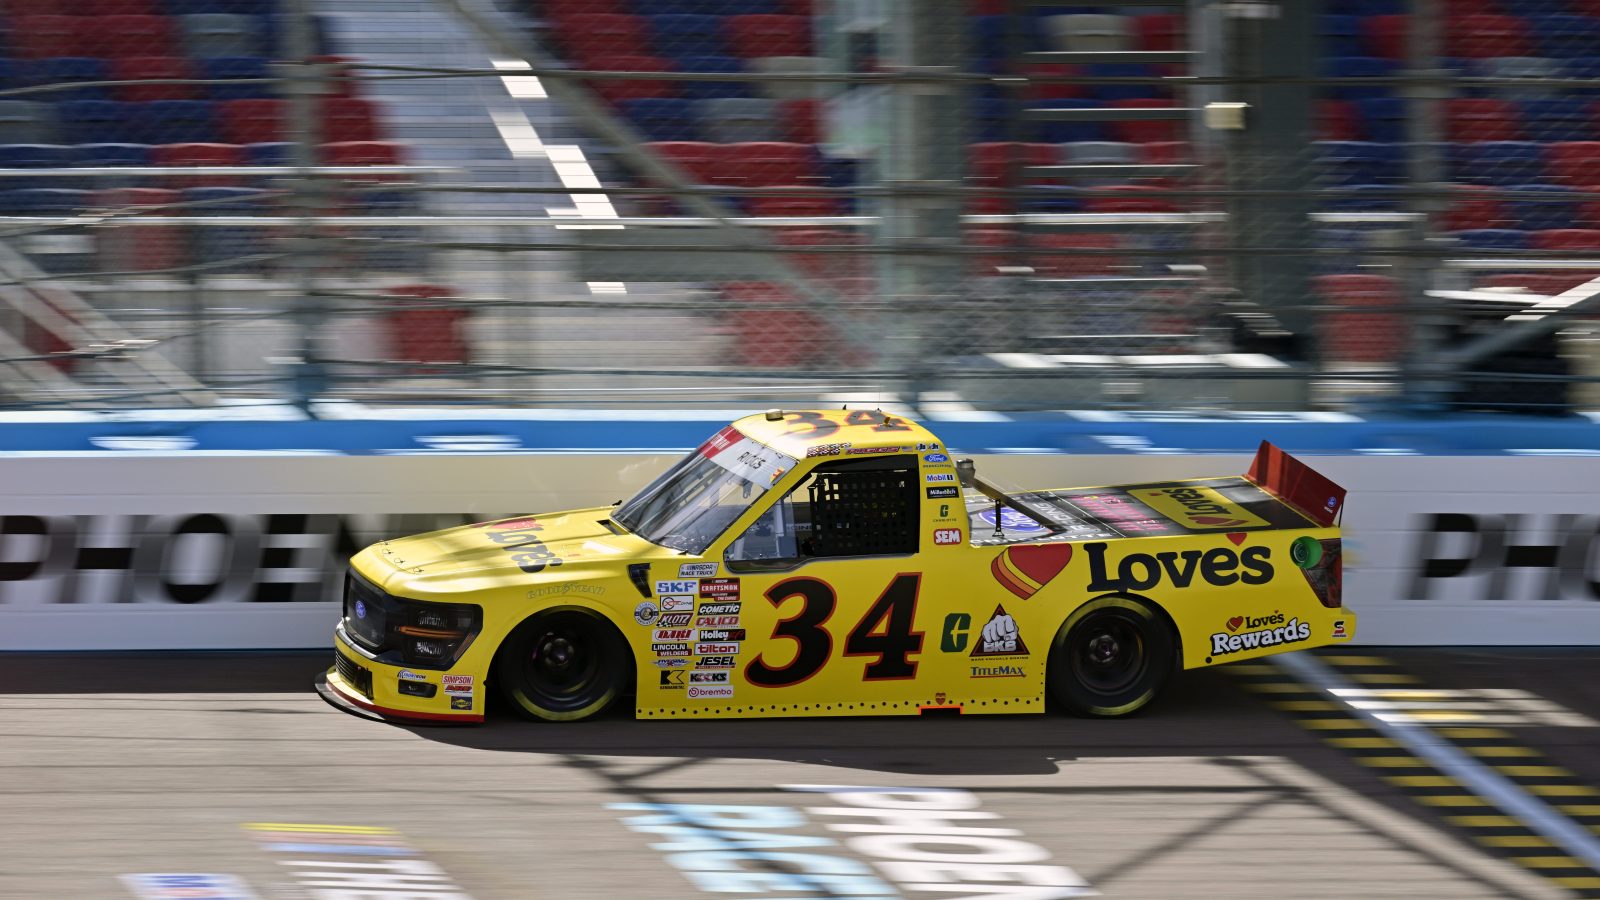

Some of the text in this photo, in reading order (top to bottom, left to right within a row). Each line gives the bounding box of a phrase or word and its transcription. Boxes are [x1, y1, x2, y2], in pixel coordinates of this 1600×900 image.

[778, 410, 912, 438] 34
[737, 451, 766, 469] RIGGS
[927, 454, 945, 462] Ford
[927, 474, 946, 482] Mobil
[935, 530, 960, 543] SEM
[657, 582, 697, 592] SKF
[700, 604, 740, 613] COMETIC
[661, 615, 691, 624] KLOTZ
[696, 616, 739, 625] CALICO
[744, 572, 925, 688] 34
[701, 631, 729, 640] Holley
[1211, 617, 1311, 656] Rewards
[698, 645, 736, 654] tilton
[983, 640, 1017, 652] BKB
[696, 656, 737, 665] JESEL
[443, 676, 472, 684] SIMPSON
[700, 688, 732, 696] brembo
[603, 803, 901, 900] RACE
